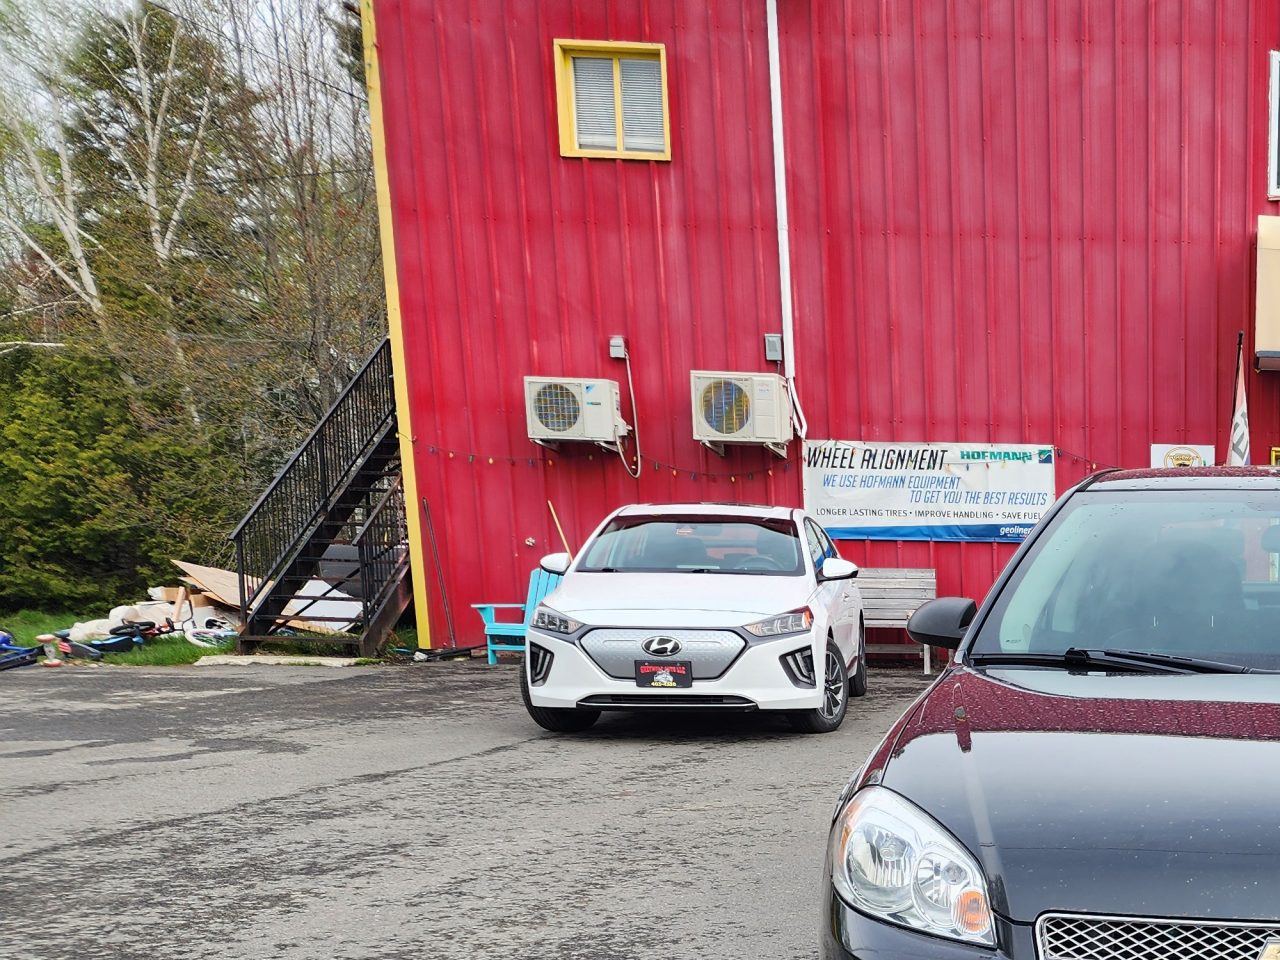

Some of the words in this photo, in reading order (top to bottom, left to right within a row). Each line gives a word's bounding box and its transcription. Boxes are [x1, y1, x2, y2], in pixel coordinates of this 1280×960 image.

[807, 446, 855, 470] WHEEL
[860, 448, 948, 471] ALIGNMENT
[960, 450, 1032, 461] HOFMANN
[823, 473, 838, 488] WE
[840, 474, 859, 488] USE
[860, 474, 906, 489] HOFMANN
[908, 475, 961, 490] EQUIPMENT
[910, 490, 923, 504] TO
[924, 490, 942, 504] GET
[943, 490, 963, 504] YOU
[965, 491, 984, 505] THE
[983, 491, 1007, 505] BEST
[1008, 492, 1048, 506] RESULTS
[816, 508, 847, 516] LONGER
[849, 508, 883, 517] LASTING
[885, 509, 908, 517] TIRES
[914, 510, 951, 518] IMPROVE
[953, 511, 994, 519] HANDLING
[1002, 511, 1021, 519] SAVE
[1024, 512, 1041, 520] FUEL
